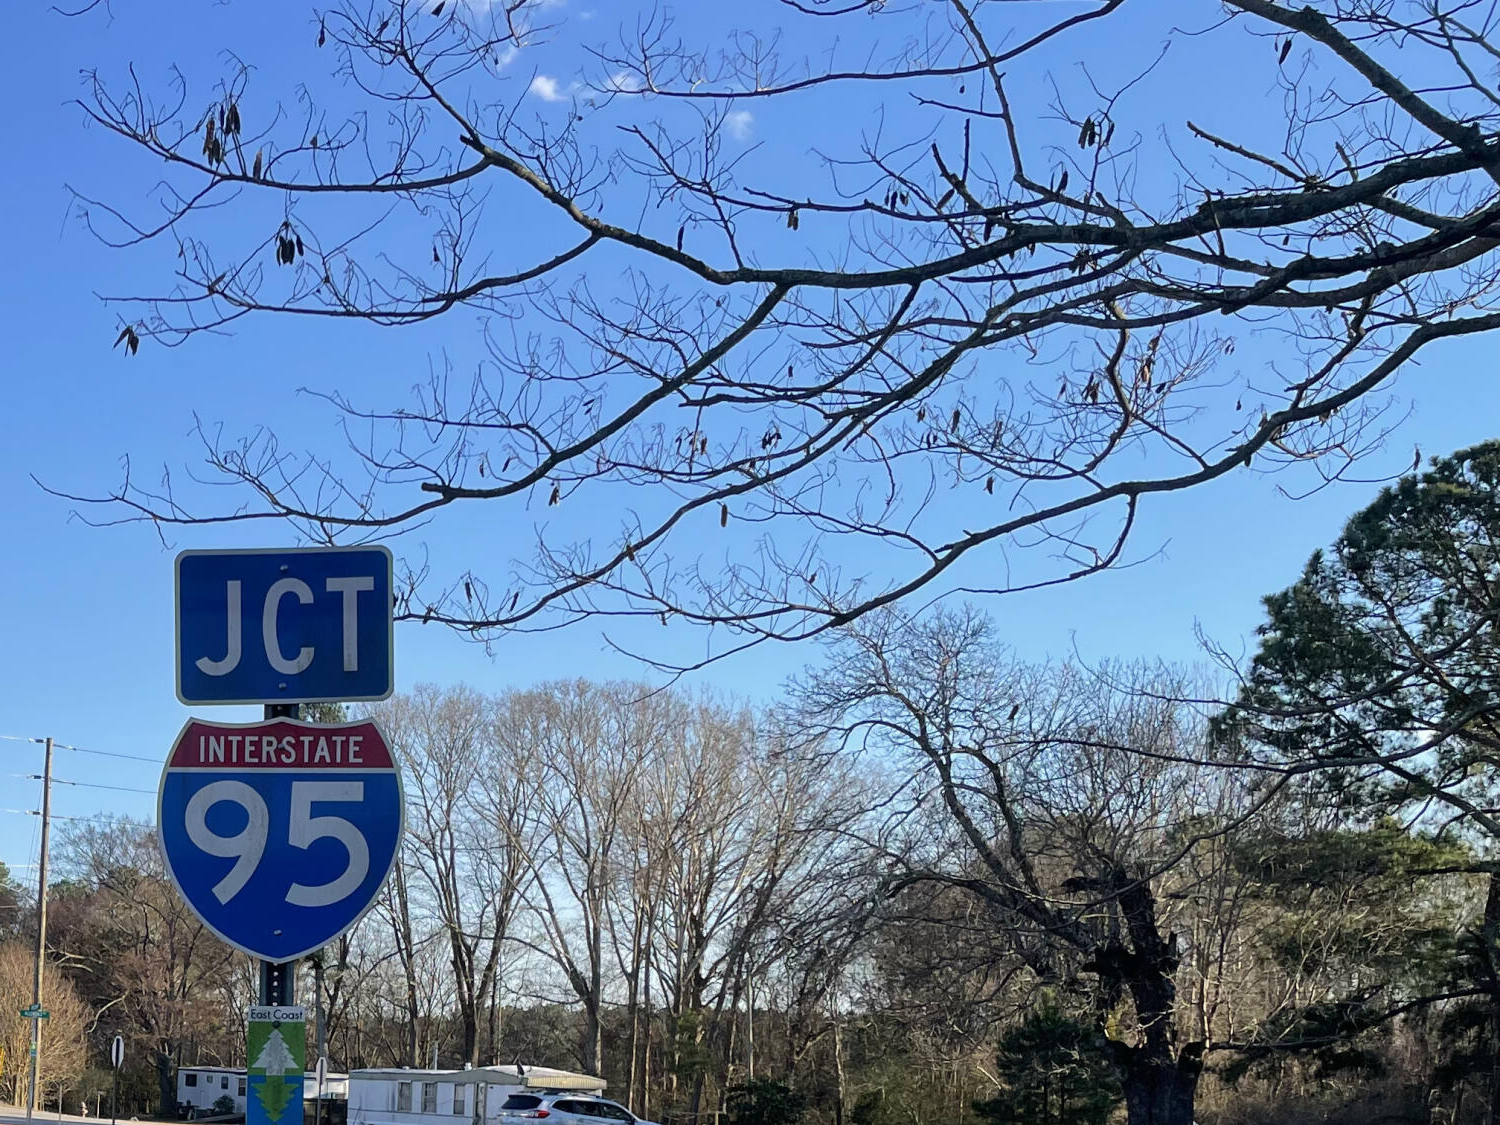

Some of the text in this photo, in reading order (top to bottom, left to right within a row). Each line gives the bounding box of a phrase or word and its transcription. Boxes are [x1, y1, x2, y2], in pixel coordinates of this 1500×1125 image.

[195, 576, 374, 676] JCT
[199, 735, 363, 763] INTERSTATE
[184, 780, 370, 908] 95
[250, 1008, 303, 1020] East Coast
